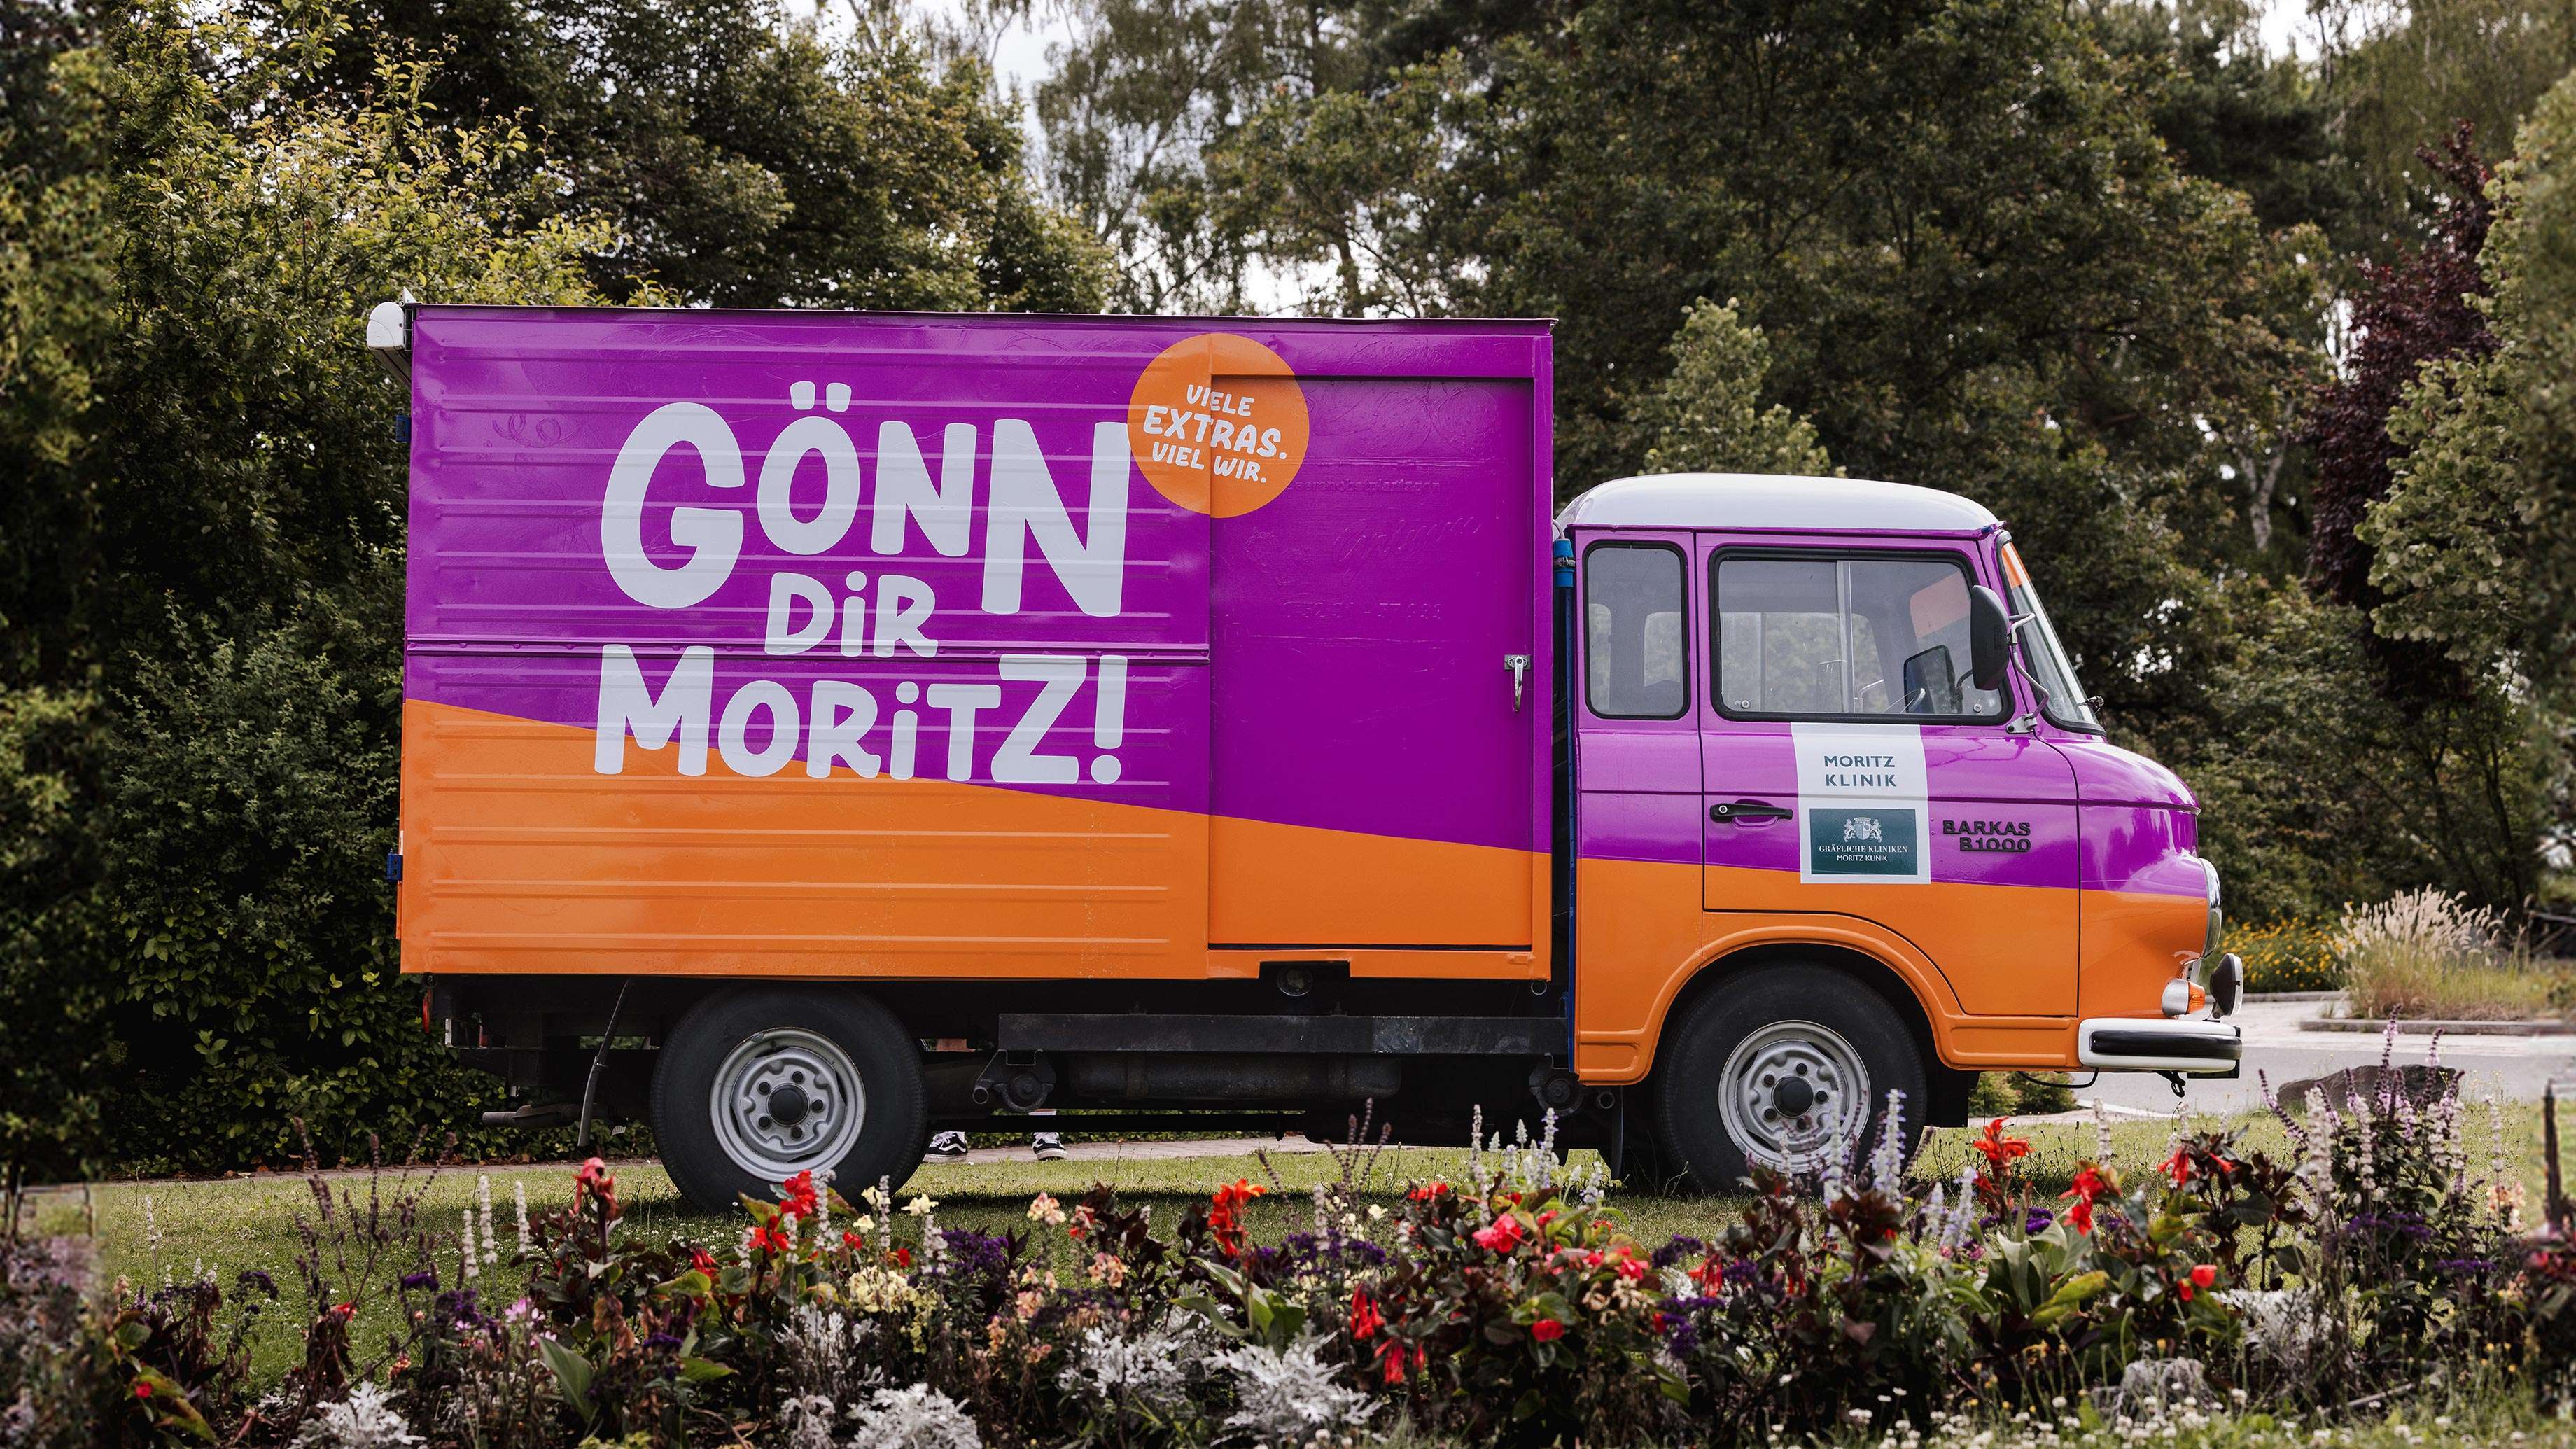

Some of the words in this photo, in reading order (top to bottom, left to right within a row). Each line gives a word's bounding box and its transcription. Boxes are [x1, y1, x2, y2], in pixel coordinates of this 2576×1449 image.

[1186, 384, 1254, 416] VIELE
[1143, 405, 1287, 460] EXTRAS.
[1152, 442, 1205, 470] VIEL
[1213, 456, 1266, 483] WIR.
[601, 382, 1131, 617] GÖNN
[1823, 755, 1896, 768] MORITZ
[1826, 774, 1897, 788] KLINIK
[1943, 820, 2031, 836] BARKAS
[1819, 844, 1866, 853] GRÄFLICHE
[1960, 837, 2031, 853] B1000
